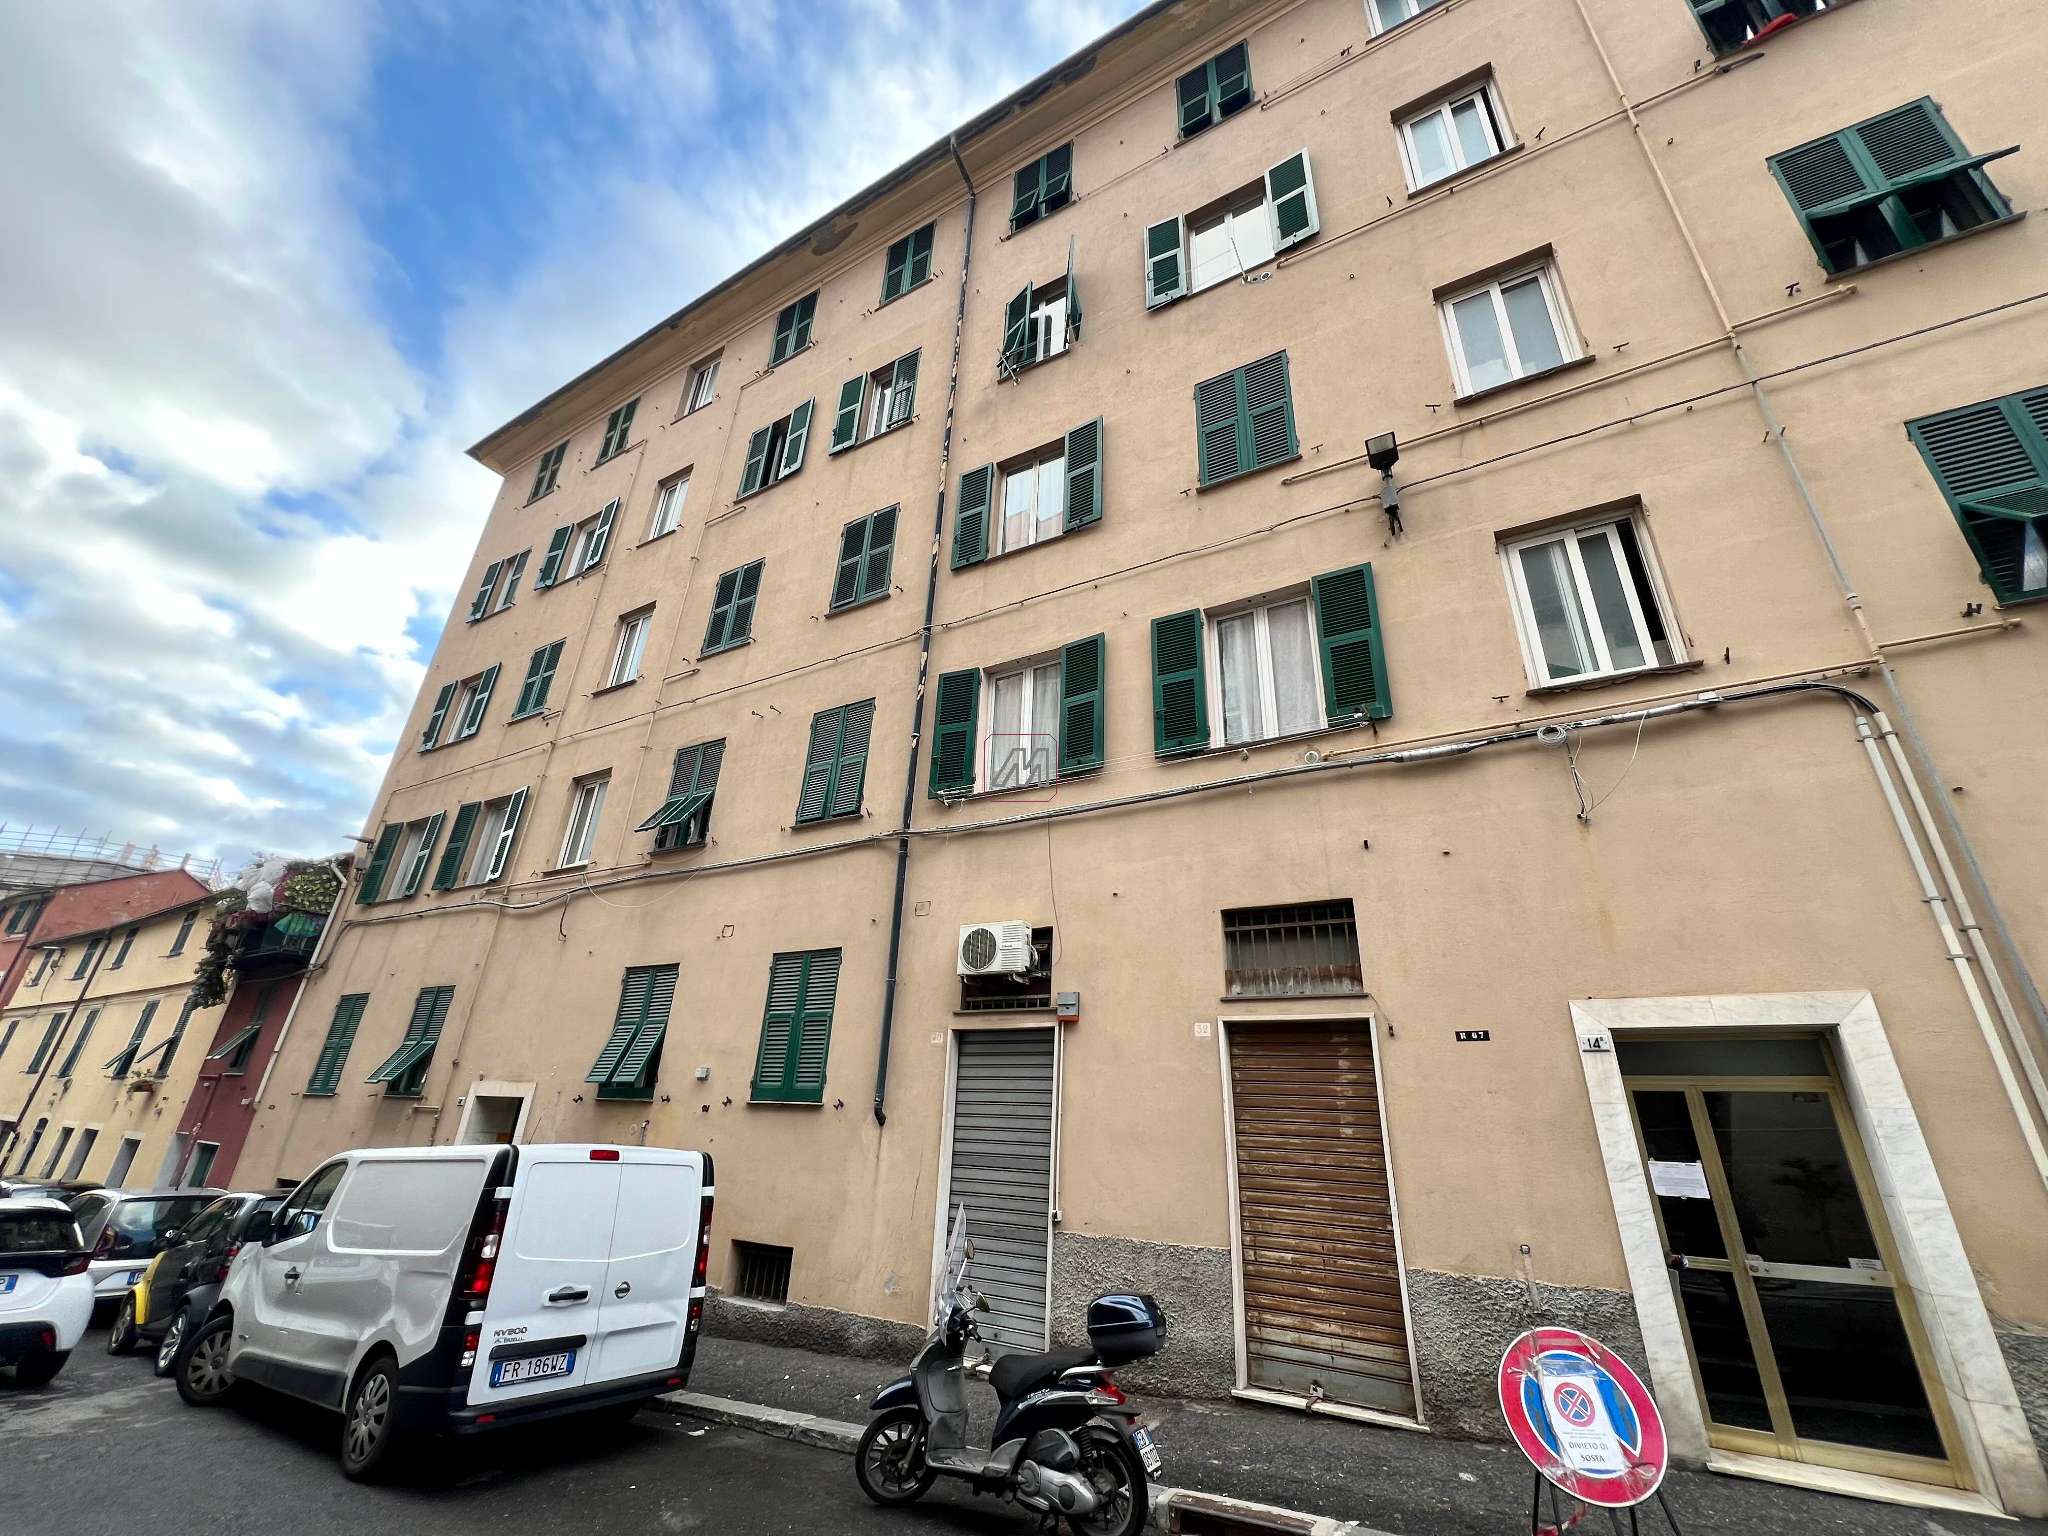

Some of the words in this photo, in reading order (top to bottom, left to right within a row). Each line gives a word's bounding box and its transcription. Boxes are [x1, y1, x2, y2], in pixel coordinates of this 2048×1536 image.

[502, 1361, 521, 1380] FR
[527, 1354, 567, 1377] 186WZ
[1568, 1441, 1599, 1450] DIVIETO
[1599, 1442, 1609, 1451] DI
[1580, 1454, 1606, 1463] SOSTA
